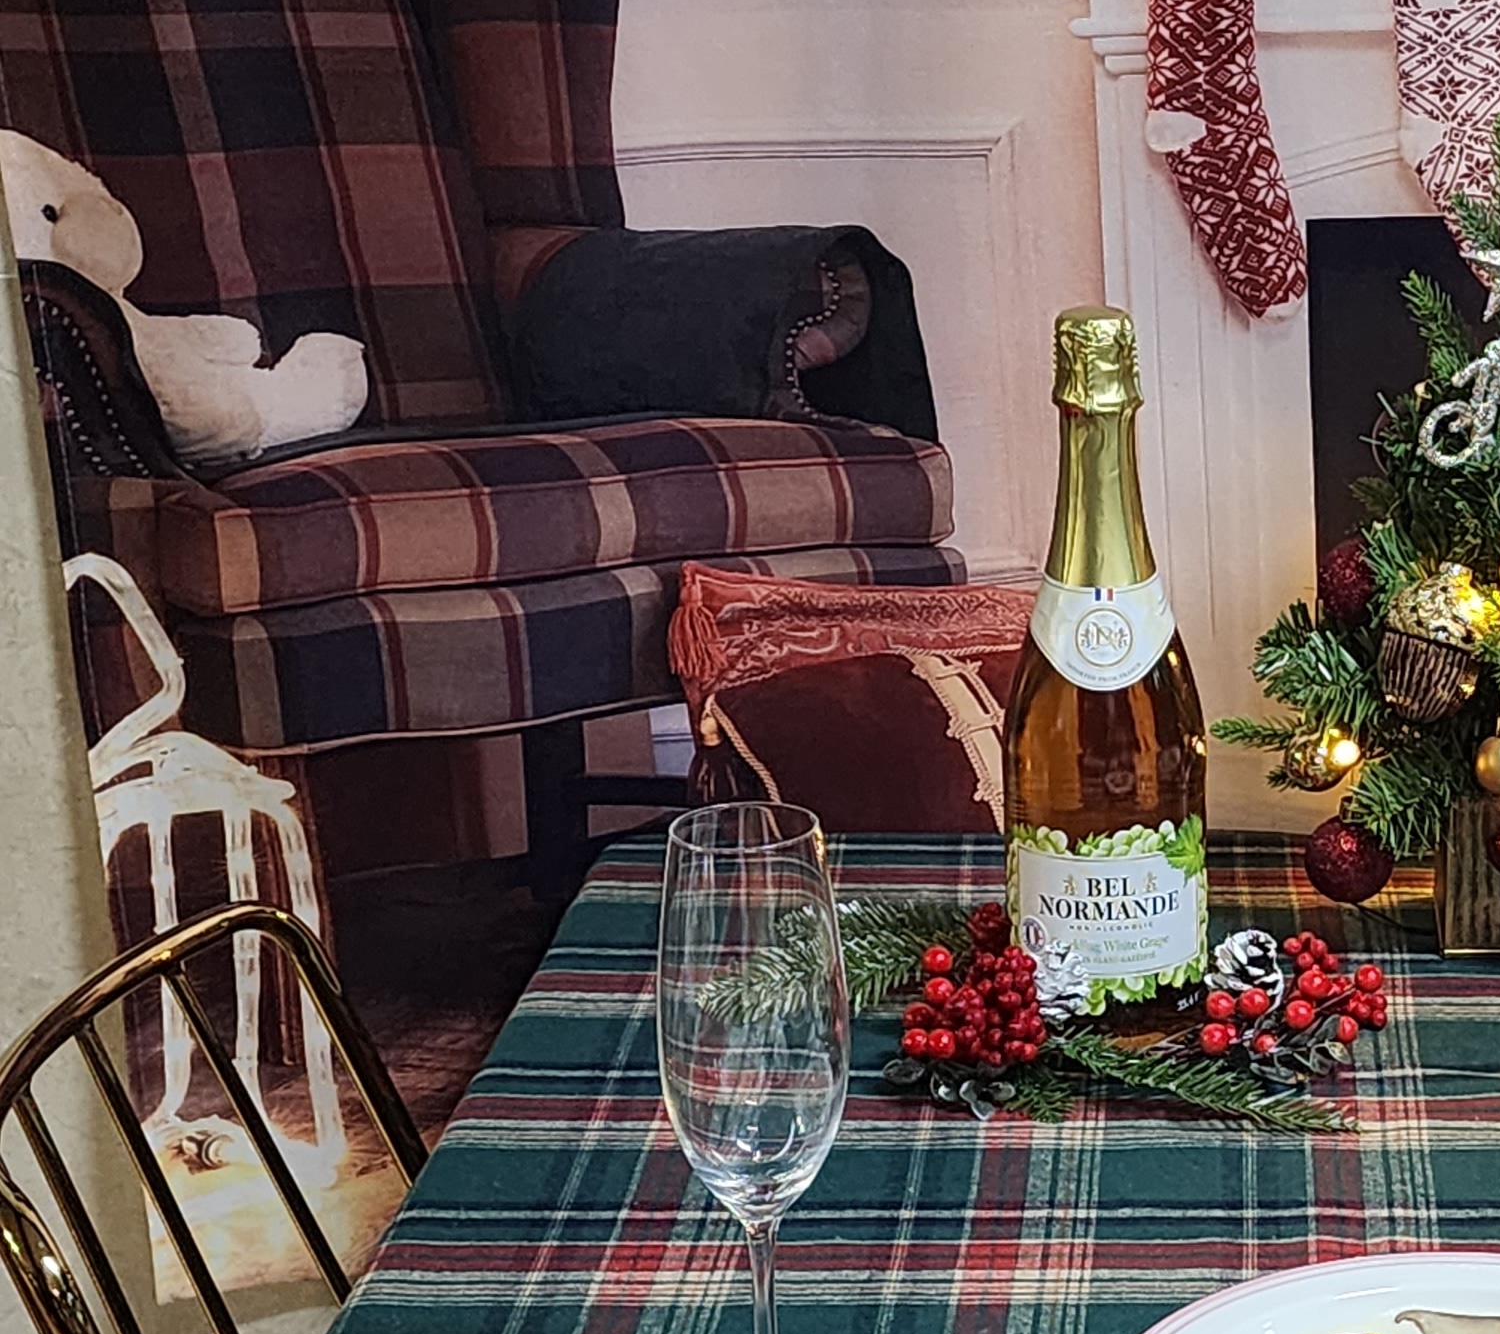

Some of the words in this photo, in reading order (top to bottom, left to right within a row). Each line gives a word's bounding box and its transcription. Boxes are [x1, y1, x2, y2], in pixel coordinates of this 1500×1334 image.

[1086, 876, 1136, 897] BEL
[1038, 889, 1180, 921] NORMANDE
[1069, 923, 1090, 931] NON
[1096, 921, 1153, 932] ALCOHOLIC
[1104, 938, 1137, 953] White
